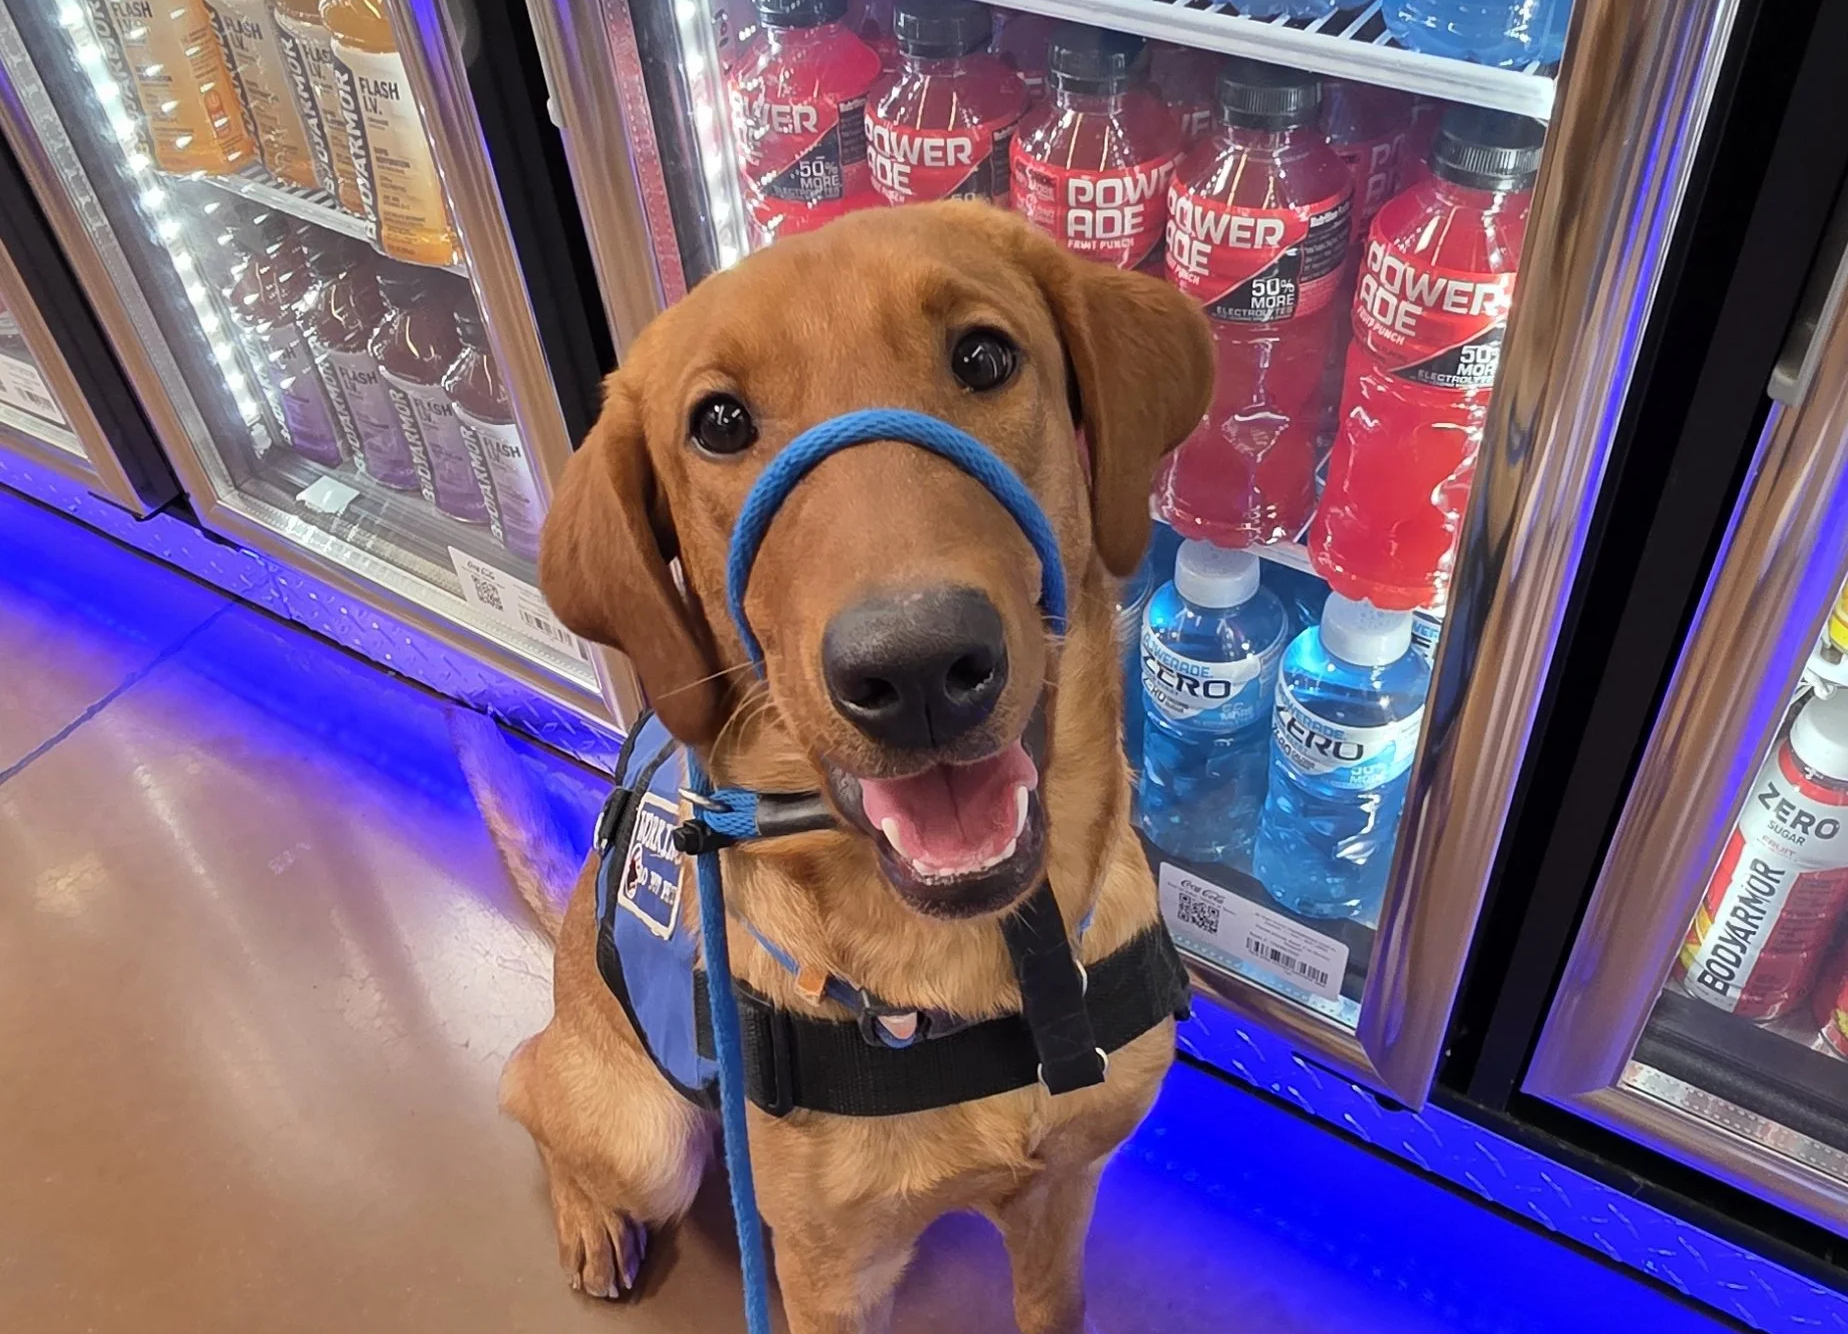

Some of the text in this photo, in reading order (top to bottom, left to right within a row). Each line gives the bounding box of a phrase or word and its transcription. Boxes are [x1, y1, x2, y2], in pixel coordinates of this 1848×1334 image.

[111, 1, 153, 18] FLASH
[358, 76, 400, 101] FLASH
[362, 96, 383, 116] I.V.
[334, 69, 377, 241] BODYARMOR
[864, 113, 972, 167] POWER
[799, 160, 838, 178] 50%
[800, 176, 841, 190] MORE
[867, 145, 913, 196] ADE
[1067, 204, 1145, 239] ADE
[1167, 185, 1285, 249] POWER
[1100, 237, 1135, 250] PUNCH
[1165, 219, 1212, 277] ADE
[1251, 278, 1295, 298] 50%
[1367, 240, 1512, 317] POWER
[1250, 294, 1295, 309] MORE
[1360, 273, 1423, 337] ADE
[1373, 322, 1405, 346] PUNCH
[1143, 651, 1232, 700] ZERO
[1275, 705, 1364, 762] ZERO
[1757, 781, 1841, 841] ZERO
[1767, 819, 1807, 847] SUGAR
[1697, 858, 1786, 997] BODYARMOR
